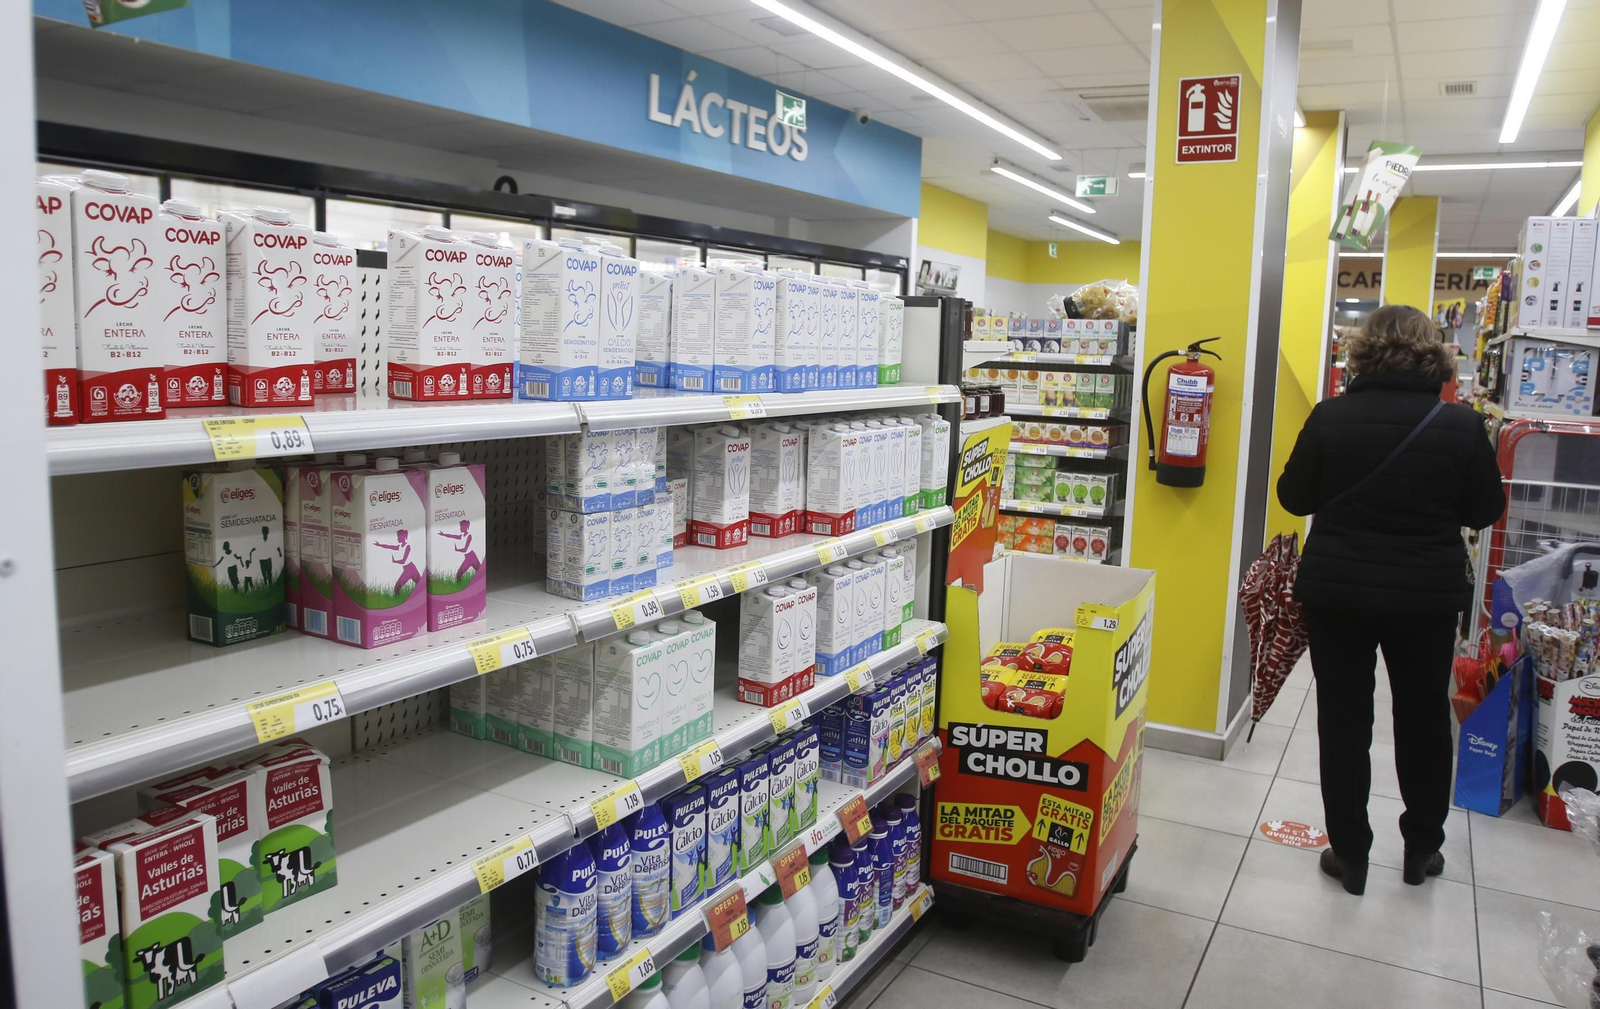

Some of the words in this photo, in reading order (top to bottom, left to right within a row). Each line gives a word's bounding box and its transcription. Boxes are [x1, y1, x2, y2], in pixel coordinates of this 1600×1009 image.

[648, 69, 808, 161] LÁCTEOS
[1182, 143, 1232, 154] EXTINTOR
[85, 201, 153, 225] COVAP
[165, 227, 221, 246] COVAP
[253, 232, 308, 250] COVAP
[313, 252, 353, 267] COVAP
[425, 248, 467, 264] COVAP
[475, 253, 513, 267] COVAP
[566, 257, 598, 272] COVAP
[606, 263, 637, 277] COVAP
[753, 280, 775, 291] COVAP
[787, 281, 807, 294] COVAP
[823, 288, 838, 298] COVAP
[840, 290, 856, 300] COVAP
[860, 292, 878, 302] COVAP
[104, 328, 146, 338] ENTERA
[179, 330, 213, 339] ENTERA
[267, 333, 300, 341] ENTERA
[607, 338, 631, 347] CALCIO
[1177, 377, 1198, 386] Chubb
[149, 390, 158, 398] 89
[859, 435, 872, 444] COVAP
[874, 433, 887, 443] COVAP
[890, 430, 904, 440] COVAP
[908, 429, 920, 438] COVAP
[727, 442, 749, 453] COVAP
[782, 438, 798, 448] COVAP
[842, 438, 857, 447] COVAP
[962, 441, 988, 468] SÚPER
[964, 456, 992, 483] CHOLLO
[230, 487, 254, 501] eliges
[378, 490, 400, 503] eliges
[443, 483, 464, 497] eliges
[962, 493, 980, 514] MITAD
[434, 510, 466, 522] DESNATADA
[636, 508, 655, 518] COVAP
[221, 514, 277, 529] SEMIDESNATADA
[369, 519, 403, 531] DESNATADA
[586, 516, 608, 527] COVAP
[952, 512, 977, 548] GRATIS
[889, 561, 903, 572] COVAP
[753, 570, 766, 583] 1,59
[836, 578, 851, 590] COVAP
[855, 573, 869, 584] COVAP
[705, 585, 719, 598] 1,59
[798, 592, 815, 605] COVAP
[641, 600, 658, 618] 0,99
[775, 600, 795, 613] COVAP
[1103, 619, 1117, 630] 1,29
[690, 628, 714, 643] COVAP
[666, 638, 689, 655] COVAP
[1114, 619, 1146, 683] SÚPER
[636, 650, 662, 667] COVAP
[922, 662, 936, 676] PULEVA
[906, 672, 921, 685] PULEVA
[890, 683, 906, 696] PULEVA
[873, 695, 890, 709] PULEVA
[850, 708, 869, 717] PULEVA
[636, 717, 659, 732] OMEGA-3
[871, 719, 888, 736] Calcio
[1562, 722, 1583, 733] Papel
[1584, 725, 1592, 733] de
[797, 732, 818, 751] PULEVA
[951, 723, 1044, 753] SÚPER
[1467, 733, 1498, 752] Disney
[1567, 740, 1592, 749] Wrapping
[708, 750, 721, 766] 1,15
[771, 747, 795, 768] PULEVA
[918, 748, 932, 758] OFERTA
[1570, 747, 1587, 755] Papier
[272, 770, 291, 782] ENTERA
[743, 762, 768, 785] PULEVA
[796, 759, 817, 781] Calcio
[966, 753, 1081, 787] CHOLLO
[273, 781, 297, 795] Valles
[298, 776, 309, 785] de
[710, 778, 738, 801] PULEVA
[771, 775, 792, 796] Calcio
[220, 792, 240, 804] WHOLE
[268, 785, 319, 812] Asturias
[623, 793, 639, 811] 1,19
[744, 792, 767, 814] Calcio
[226, 806, 238, 816] de
[674, 795, 705, 820] PULEVA
[843, 800, 861, 815] OFERTA
[941, 805, 961, 817] LA
[965, 806, 1015, 819] MITAD
[1042, 797, 1062, 810] ESTA
[1063, 803, 1091, 820] MITAD
[711, 809, 736, 831] Calcio
[940, 816, 961, 825] DEL
[963, 817, 1014, 828] PAQUETE
[1040, 805, 1090, 830] GRATIS
[634, 821, 669, 840] PULEV
[810, 829, 823, 846] ifa
[939, 823, 1013, 842] GRATIS
[1266, 830, 1318, 846] SEGURIDAD
[676, 827, 702, 851] Calcio
[1049, 837, 1069, 848] GALLO
[1283, 839, 1301, 847] POR
[144, 850, 168, 864] ENTERA
[173, 838, 196, 852] WHOLE
[144, 848, 158, 857] LECHE
[780, 849, 801, 867] OFERTA
[1047, 845, 1066, 856] FIDEO
[147, 860, 178, 879] Valles
[180, 853, 194, 866] de
[640, 855, 661, 866] Vita
[141, 864, 204, 900] Asturias
[611, 872, 628, 886] Vita
[798, 871, 808, 886] 1,15
[141, 899, 164, 912] FABRICADO
[169, 888, 188, 900] ASTURIAS
[190, 880, 206, 890] ESPAÑA
[148, 905, 161, 913] MADE
[166, 894, 185, 906] ASTURIAS
[187, 888, 199, 896] SPAIN
[578, 893, 595, 908] Vita
[714, 894, 739, 915] OFERTA
[736, 919, 748, 935] 1,15
[421, 919, 450, 952] A+D
[421, 949, 455, 975] DESNATADA
[428, 946, 445, 963] SEMI
[637, 958, 654, 978] 1,05
[327, 975, 360, 991] PULEVA
[338, 975, 397, 1009] PULEVA
